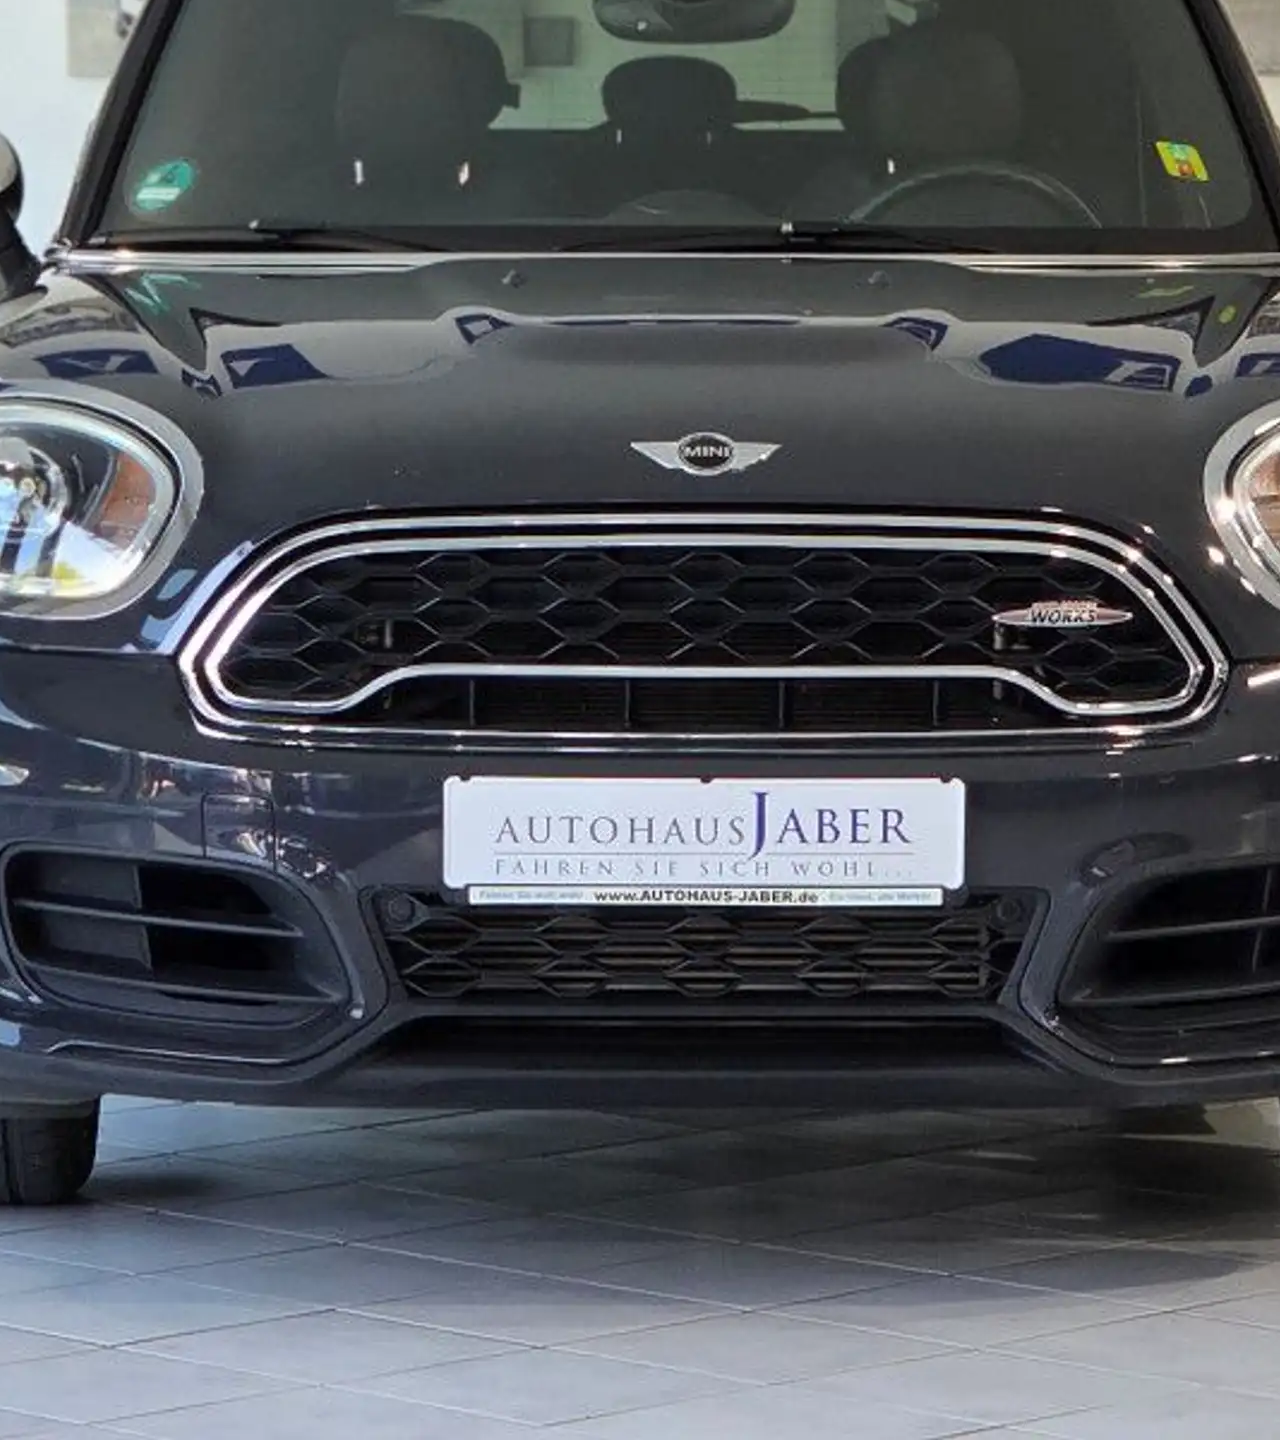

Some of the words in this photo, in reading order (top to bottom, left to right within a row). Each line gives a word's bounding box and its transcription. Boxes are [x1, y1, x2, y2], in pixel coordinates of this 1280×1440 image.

[683, 446, 730, 458] MINI
[1030, 609, 1096, 624] WORKS
[495, 859, 613, 876] FAHREN
[635, 860, 678, 876] SIE
[700, 861, 769, 877] SICH
[593, 890, 819, 904] www.AUTOHAUS-JABER.de
